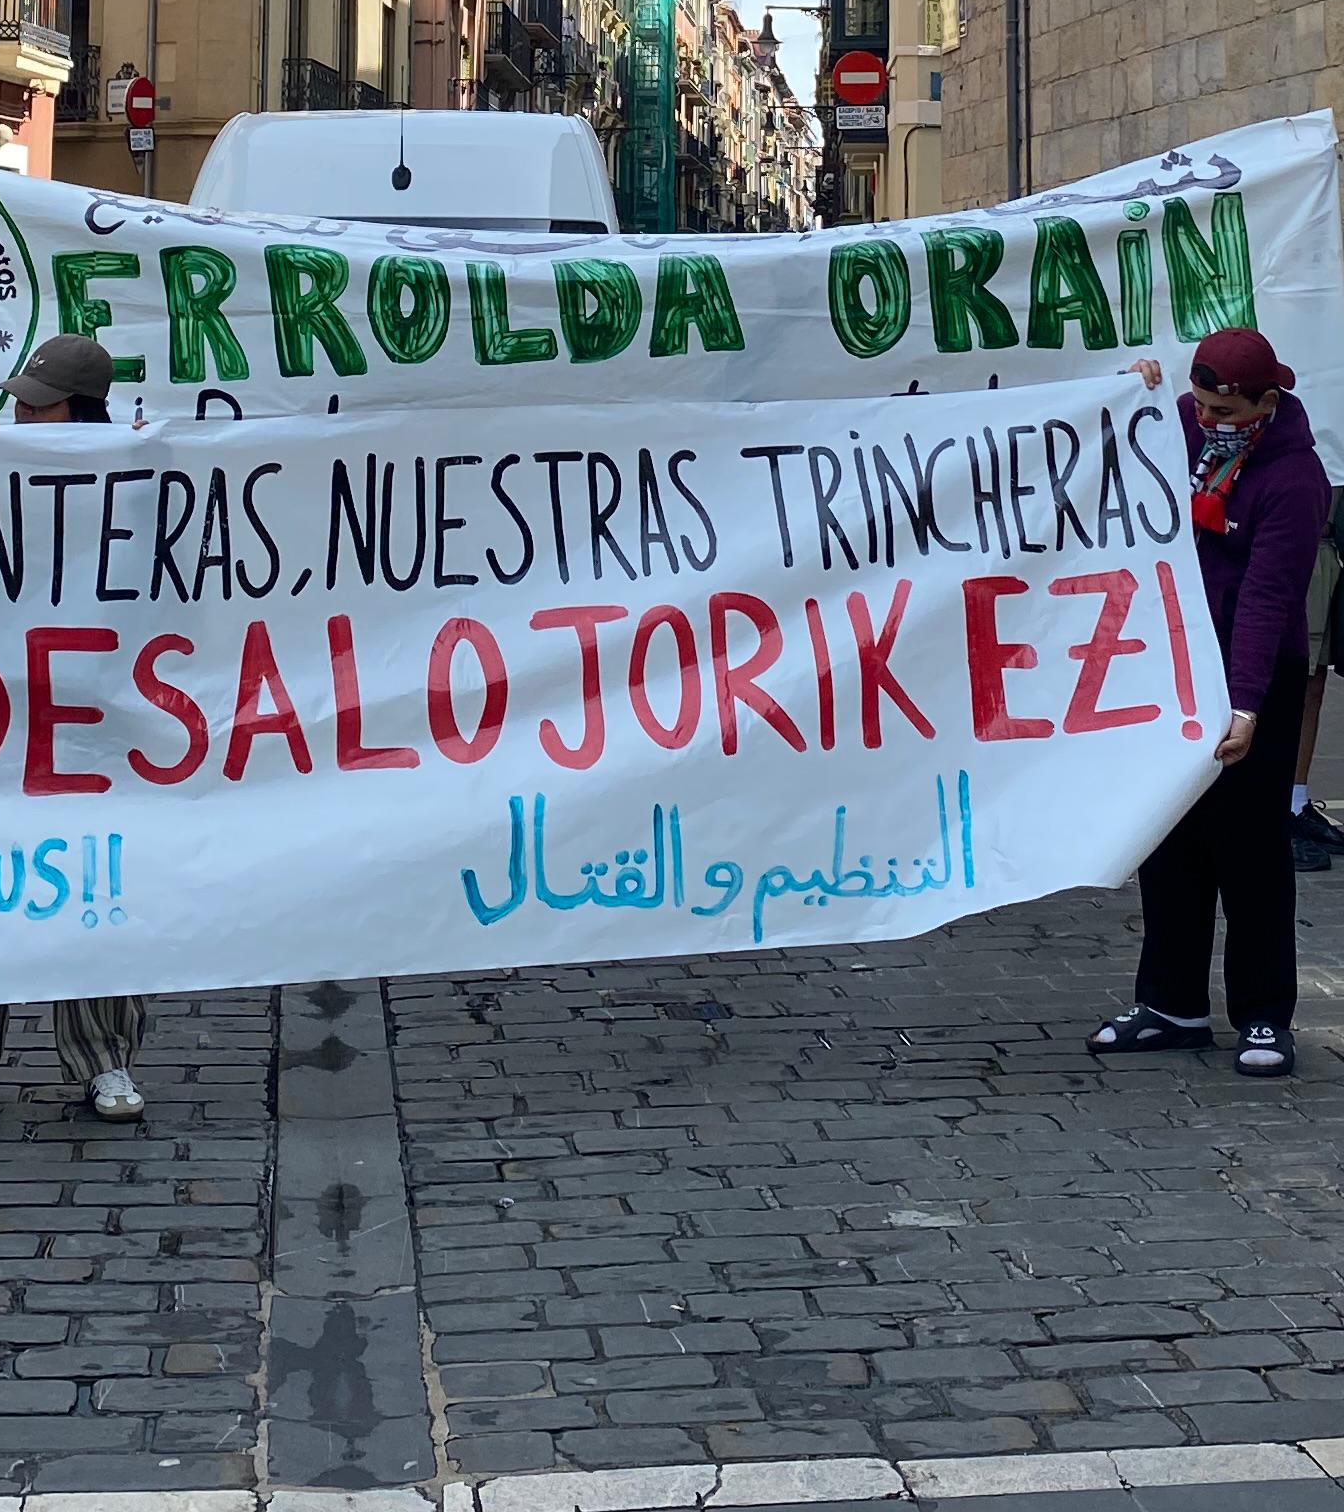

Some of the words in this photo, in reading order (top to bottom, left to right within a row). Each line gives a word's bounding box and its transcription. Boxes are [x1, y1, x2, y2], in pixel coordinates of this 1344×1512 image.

[52, 244, 745, 384] ERROLDA
[324, 448, 718, 593] NUESTRAS
[961, 560, 1203, 745] EZ!
[752, 768, 975, 944] التنظيم
